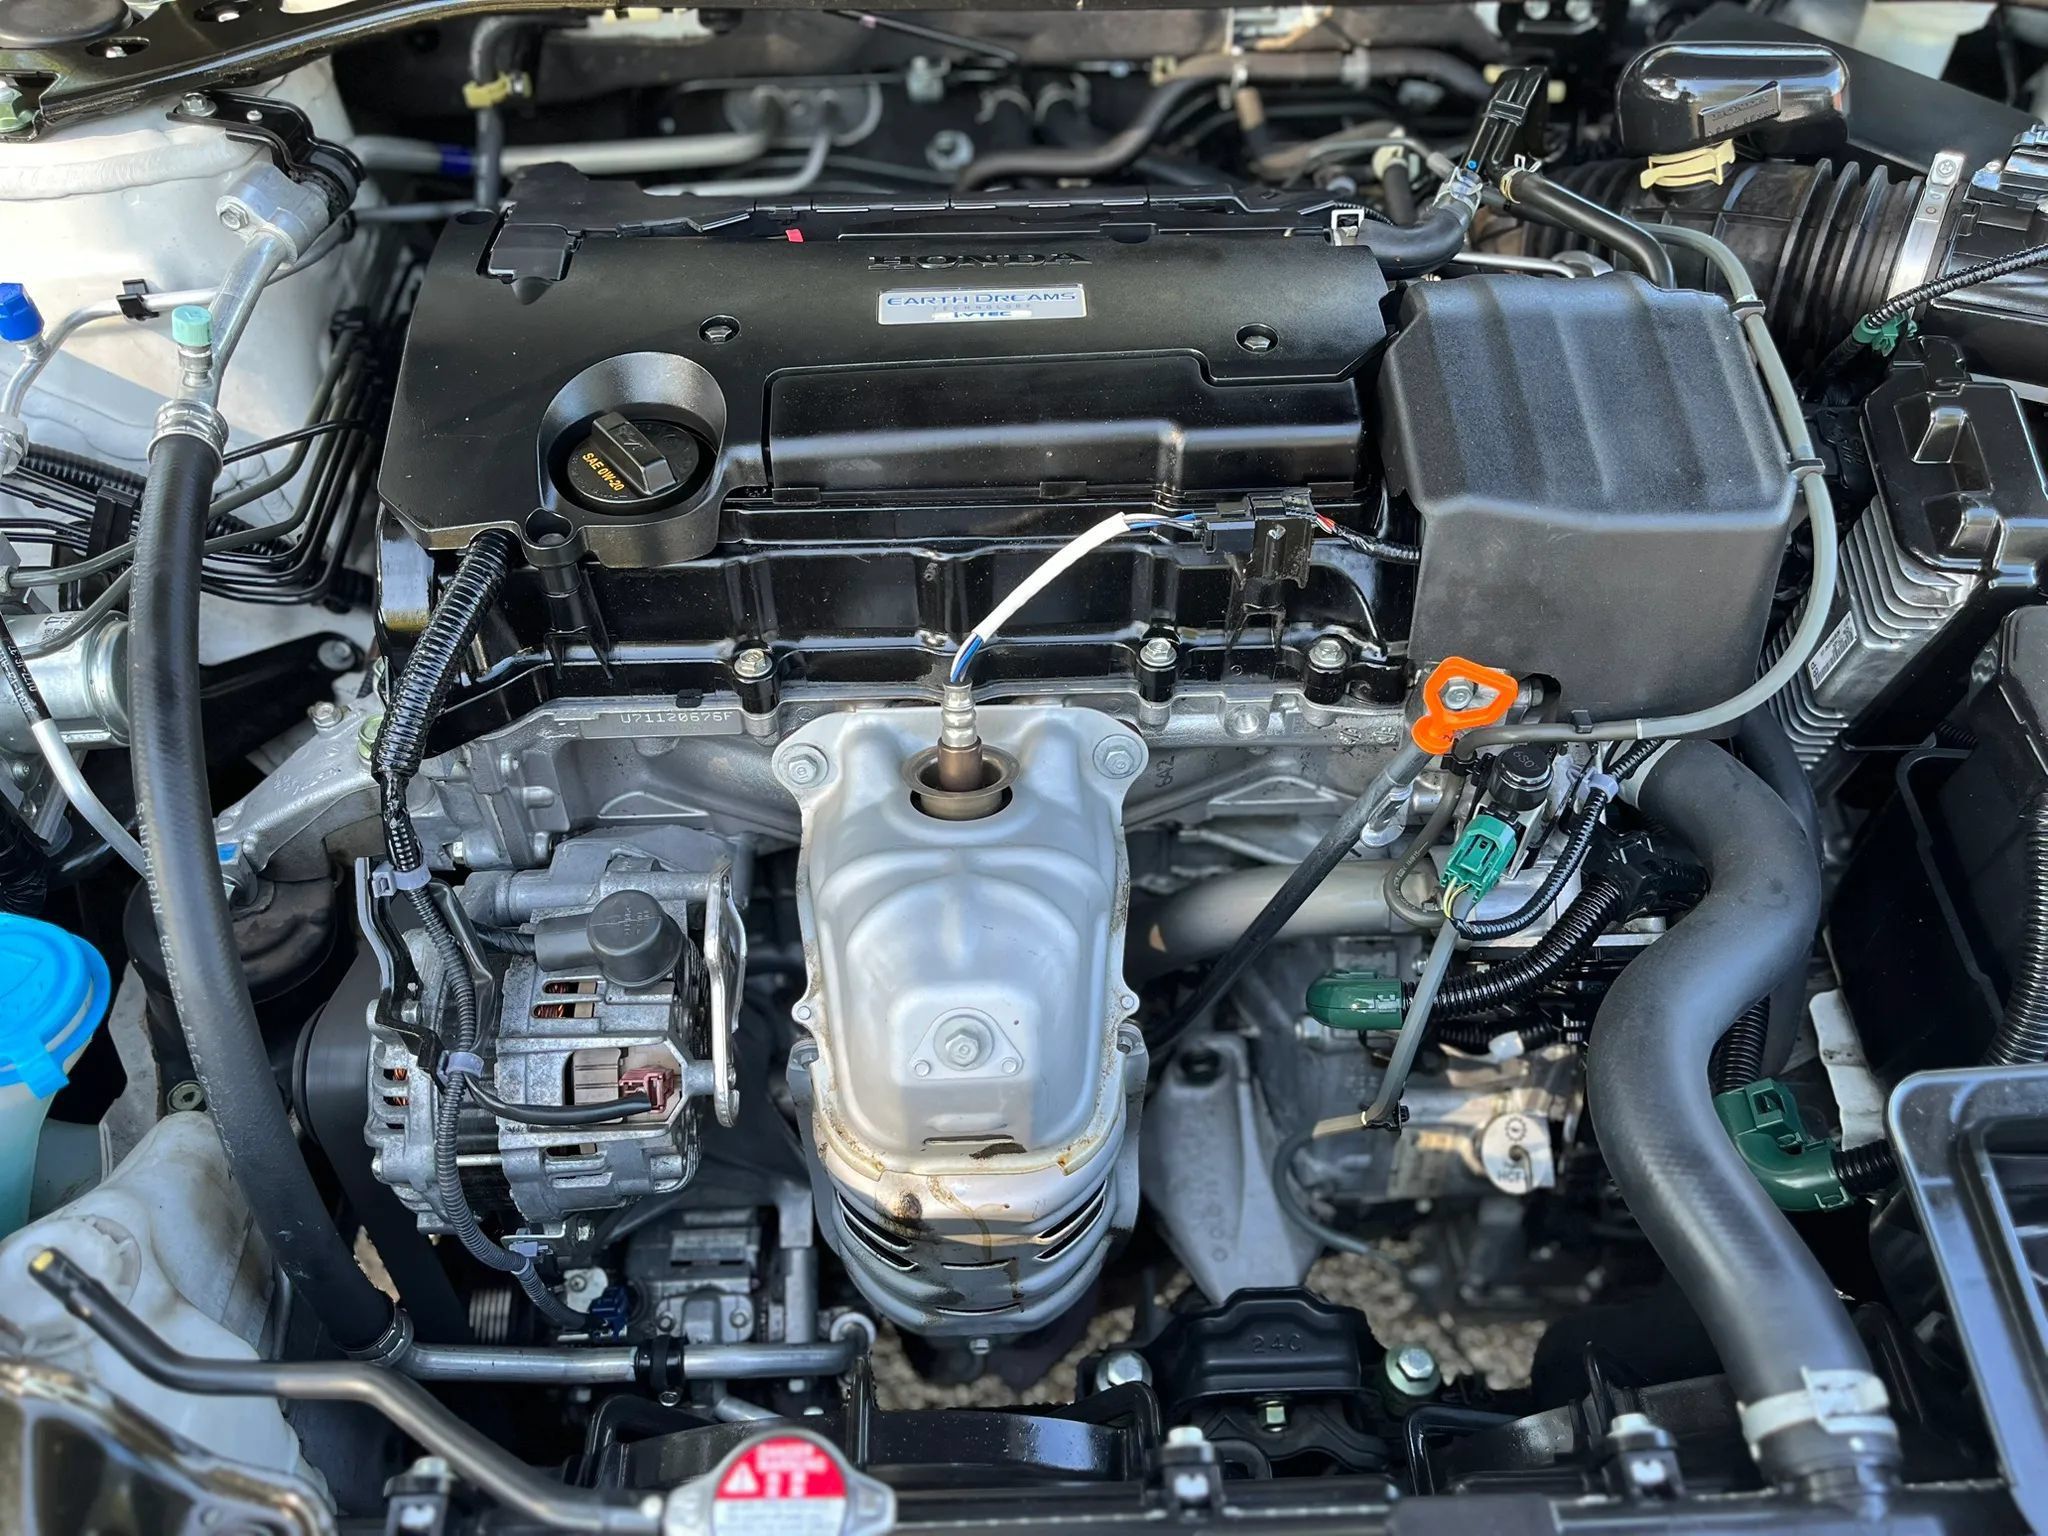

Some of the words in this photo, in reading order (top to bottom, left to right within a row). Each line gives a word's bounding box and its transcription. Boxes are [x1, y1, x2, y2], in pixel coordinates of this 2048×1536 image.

[868, 253, 1092, 270] HONDA
[888, 295, 968, 305] EARTH
[976, 292, 1075, 302] DREAMS
[582, 452, 604, 470] SAE
[598, 466, 625, 491] 0W-20
